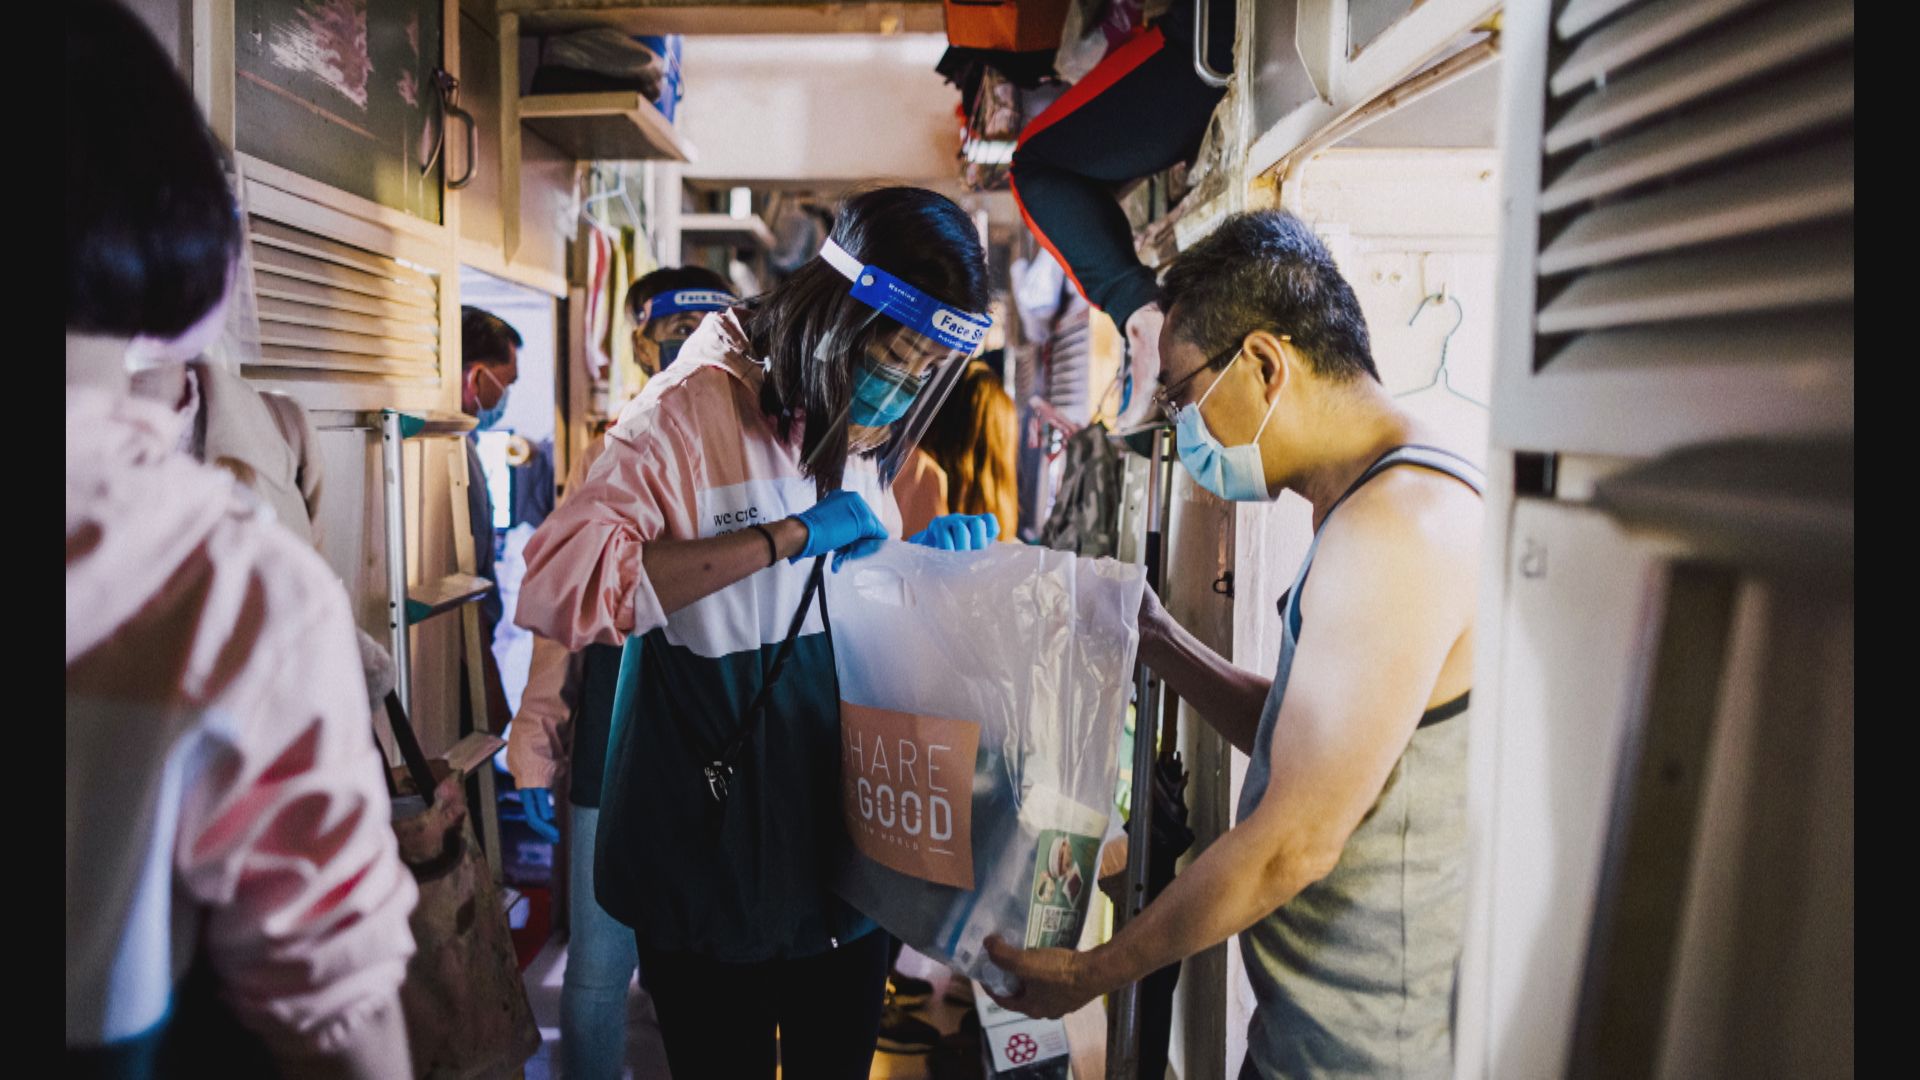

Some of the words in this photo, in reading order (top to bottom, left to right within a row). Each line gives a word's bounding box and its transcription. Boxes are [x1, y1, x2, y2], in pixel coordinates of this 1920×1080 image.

[681, 294, 707, 302] Face
[940, 315, 970, 337] Face
[713, 512, 732, 527] we
[846, 728, 952, 793] HARE
[858, 777, 953, 841] GOOD
